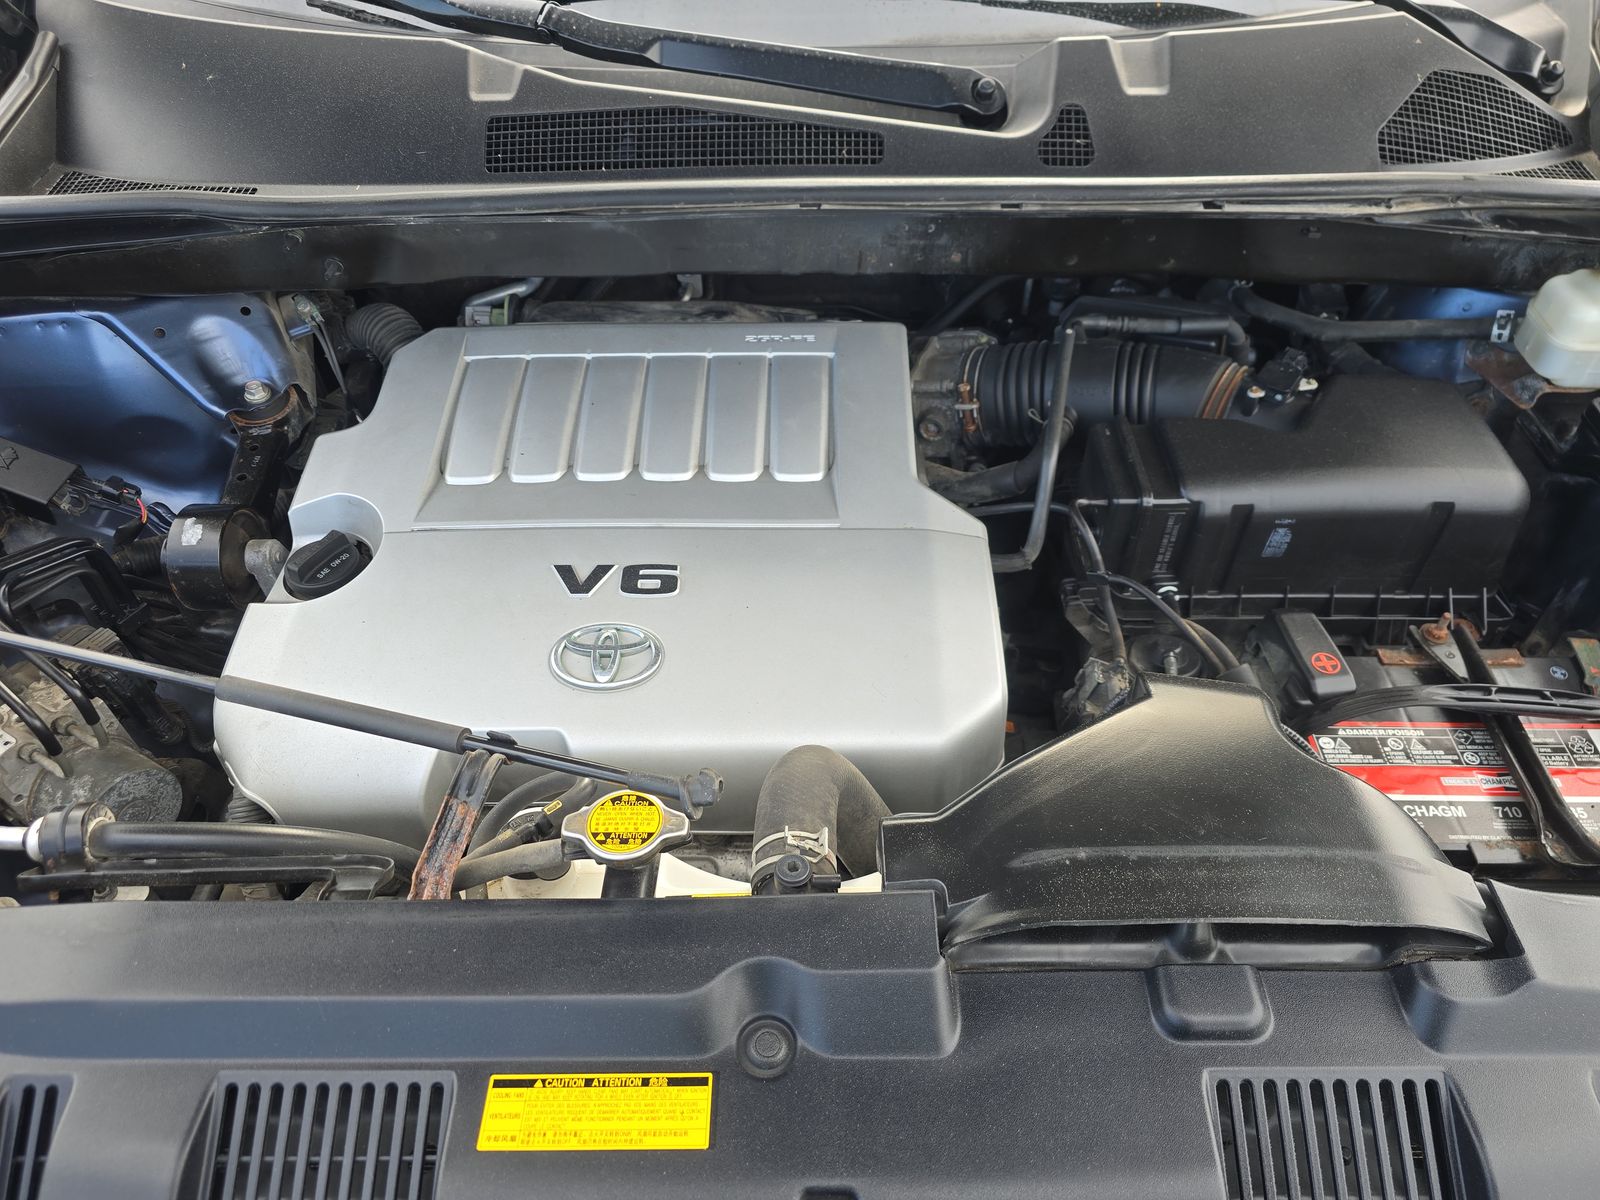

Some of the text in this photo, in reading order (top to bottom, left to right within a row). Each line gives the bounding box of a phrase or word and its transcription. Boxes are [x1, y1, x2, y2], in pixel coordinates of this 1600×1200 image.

[316, 552, 350, 578] SAE 0W-20
[550, 564, 680, 598] V6
[1403, 805, 1467, 817] CHAGM
[1493, 806, 1523, 818] 710
[545, 1078, 585, 1088] CAUTION
[592, 1078, 642, 1088] ATTENTION
